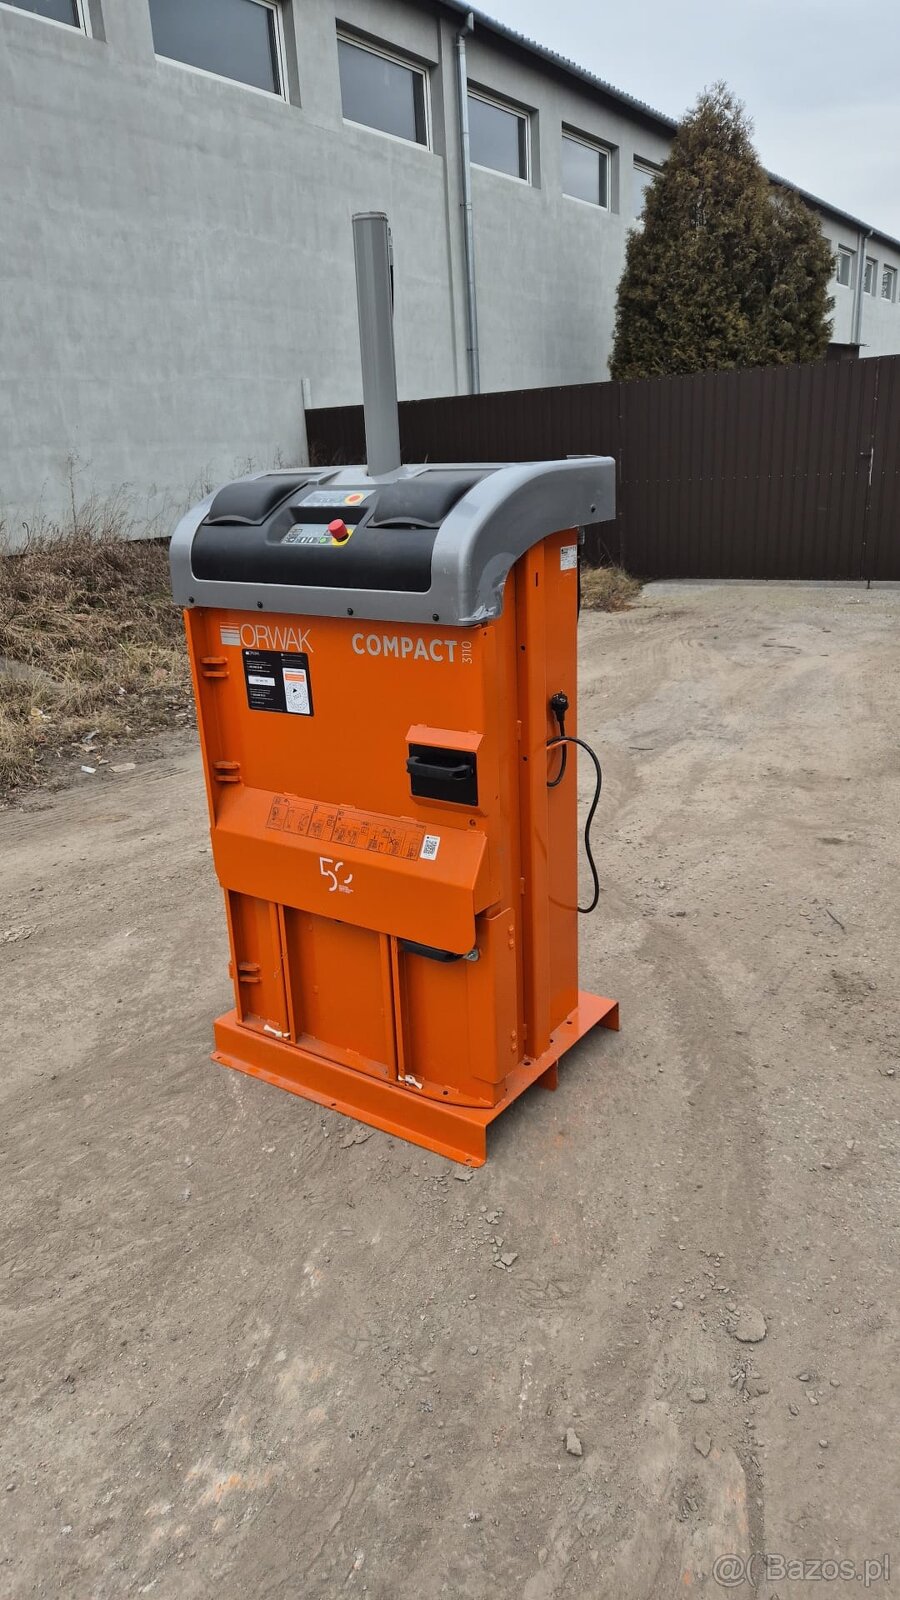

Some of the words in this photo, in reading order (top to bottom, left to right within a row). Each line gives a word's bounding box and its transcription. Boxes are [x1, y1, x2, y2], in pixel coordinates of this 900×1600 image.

[240, 623, 314, 653] ORWAK
[351, 632, 458, 663] COMPACT
[461, 640, 473, 664] 3110
